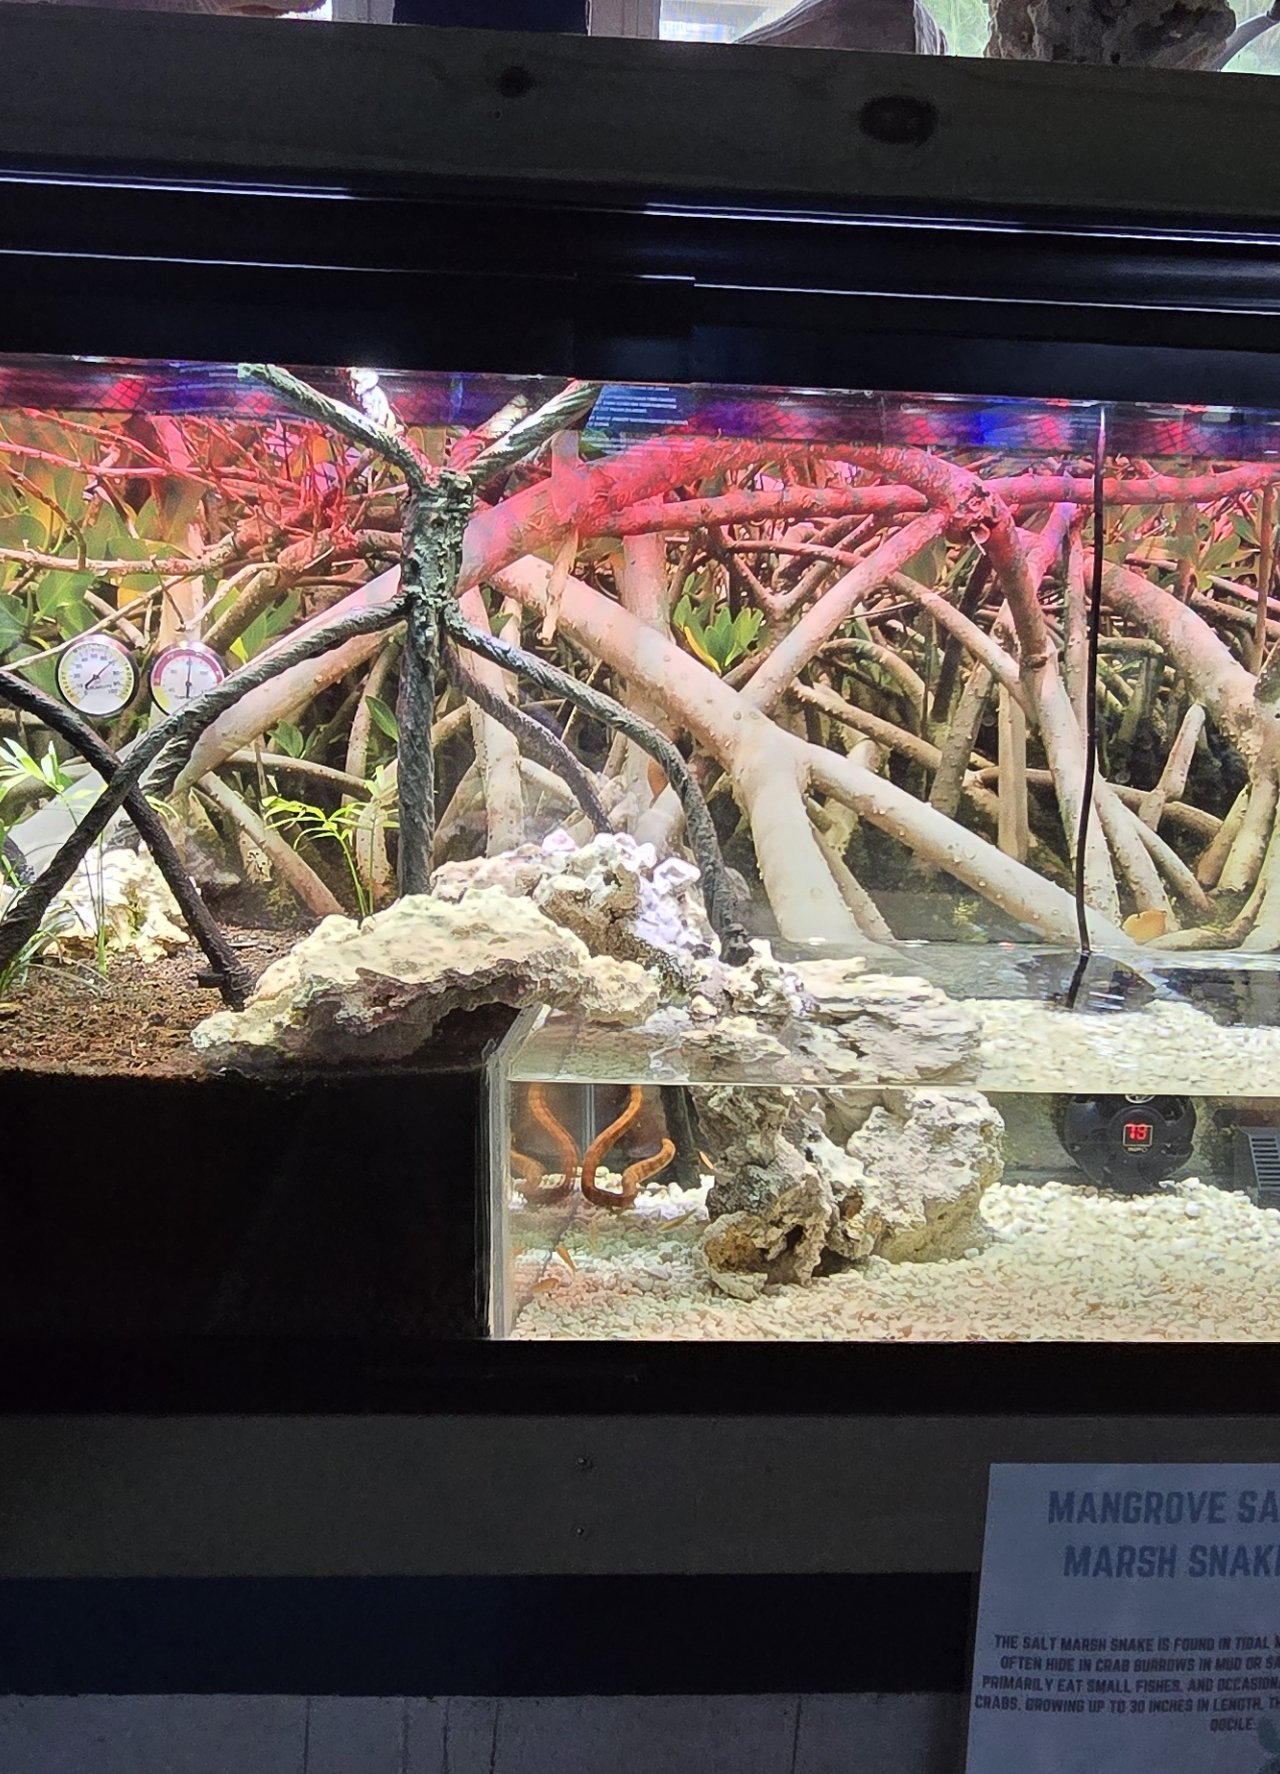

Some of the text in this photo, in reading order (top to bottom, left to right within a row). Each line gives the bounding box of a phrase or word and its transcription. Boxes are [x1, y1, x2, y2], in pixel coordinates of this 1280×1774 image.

[1047, 1489, 1227, 1525] MANGROVE
[1063, 1544, 1178, 1578] MARSH
[994, 1634, 1019, 1650] THE
[1023, 1636, 1057, 1651] SALT
[1060, 1637, 1106, 1652] MARSH
[1110, 1637, 1153, 1652] SNAKE
[1157, 1637, 1171, 1651] IS
[1174, 1637, 1215, 1651] FOUND
[1218, 1637, 1232, 1651] IN
[1235, 1636, 1270, 1651] TIDAL
[1000, 1655, 1042, 1671] OFTEN
[1045, 1657, 1075, 1672] HIDE
[1079, 1658, 1092, 1672] IN
[1095, 1659, 1130, 1673] CRAB
[1134, 1658, 1195, 1673] BURROWS
[1198, 1657, 1211, 1671] IN
[1215, 1657, 1241, 1671] MUD
[1245, 1656, 1262, 1670] OR
[982, 1675, 1054, 1692] PRIMARILY
[1057, 1678, 1083, 1693] EAT
[1087, 1679, 1131, 1693] SMALL
[1187, 1678, 1214, 1692] AND
[974, 1694, 1021, 1711] CRABS.
[1025, 1697, 1085, 1713] GROWING
[1089, 1699, 1105, 1714] UP
[1110, 1700, 1125, 1714] TO
[1130, 1700, 1145, 1714] 30
[1149, 1698, 1193, 1713] INCHES
[1197, 1698, 1210, 1712] IN
